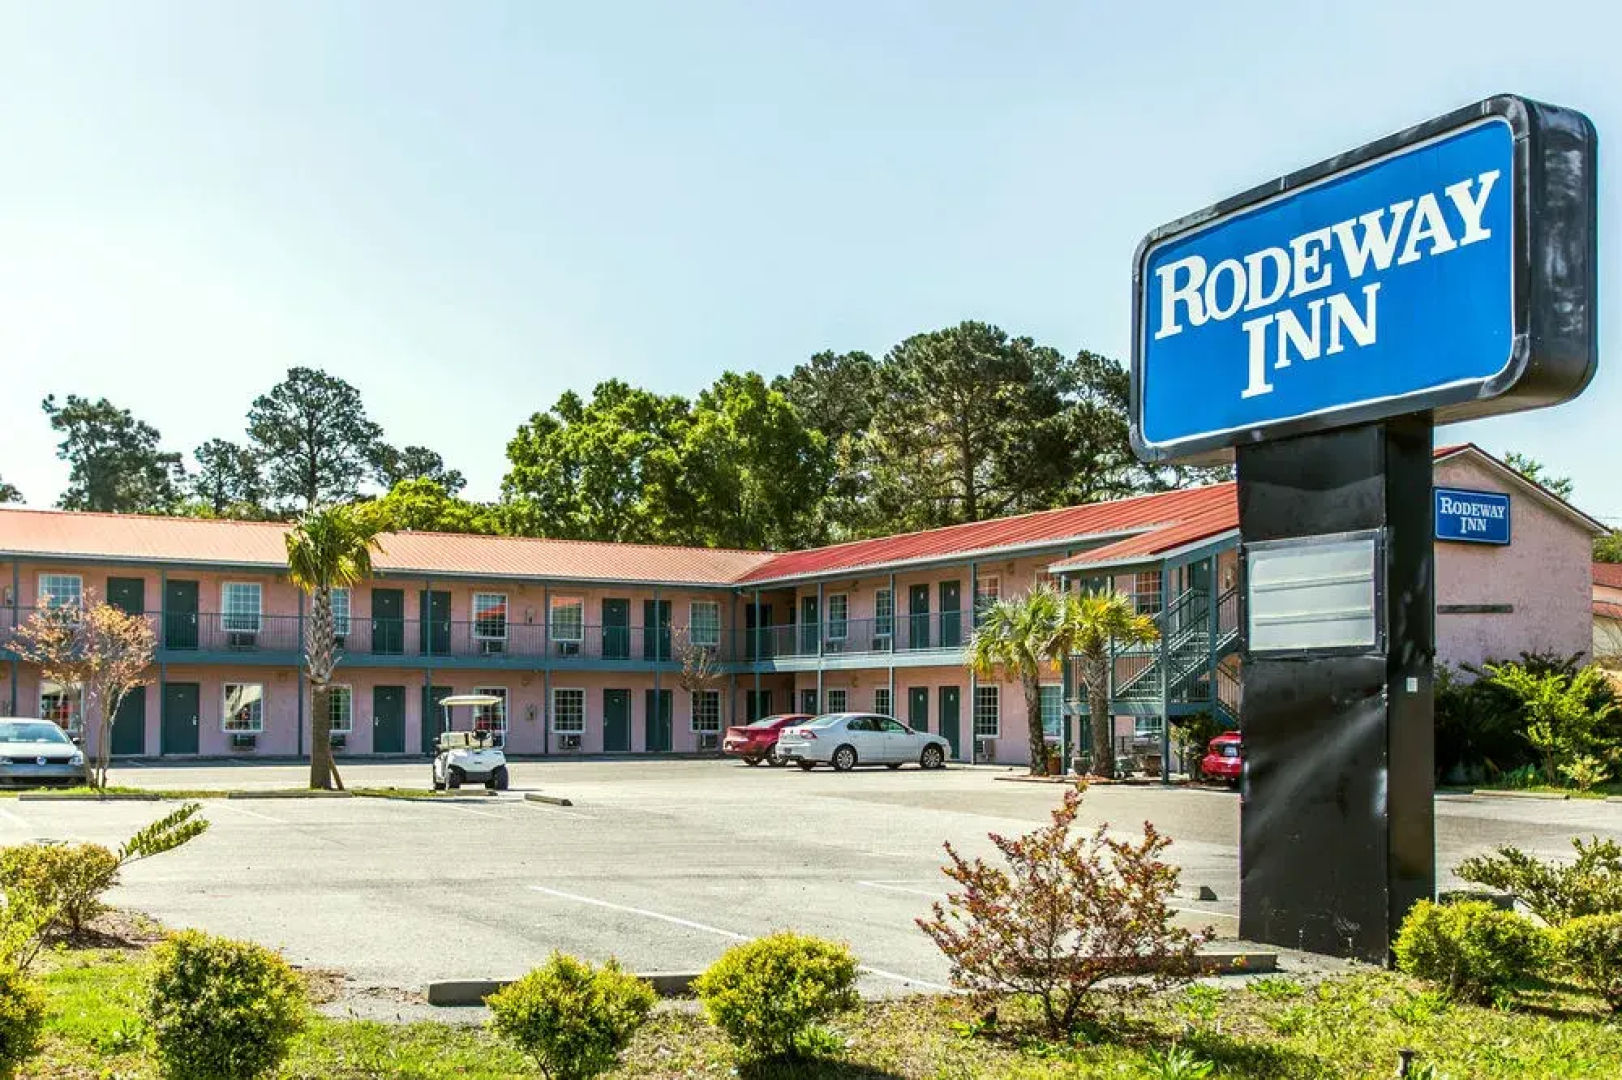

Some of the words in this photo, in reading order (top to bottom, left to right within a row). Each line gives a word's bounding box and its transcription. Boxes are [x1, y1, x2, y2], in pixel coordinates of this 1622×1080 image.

[1154, 169, 1500, 340] RODEWAY
[1241, 282, 1381, 399] INN
[1440, 497, 1505, 519] RODEWAY
[1460, 516, 1487, 534] INN
